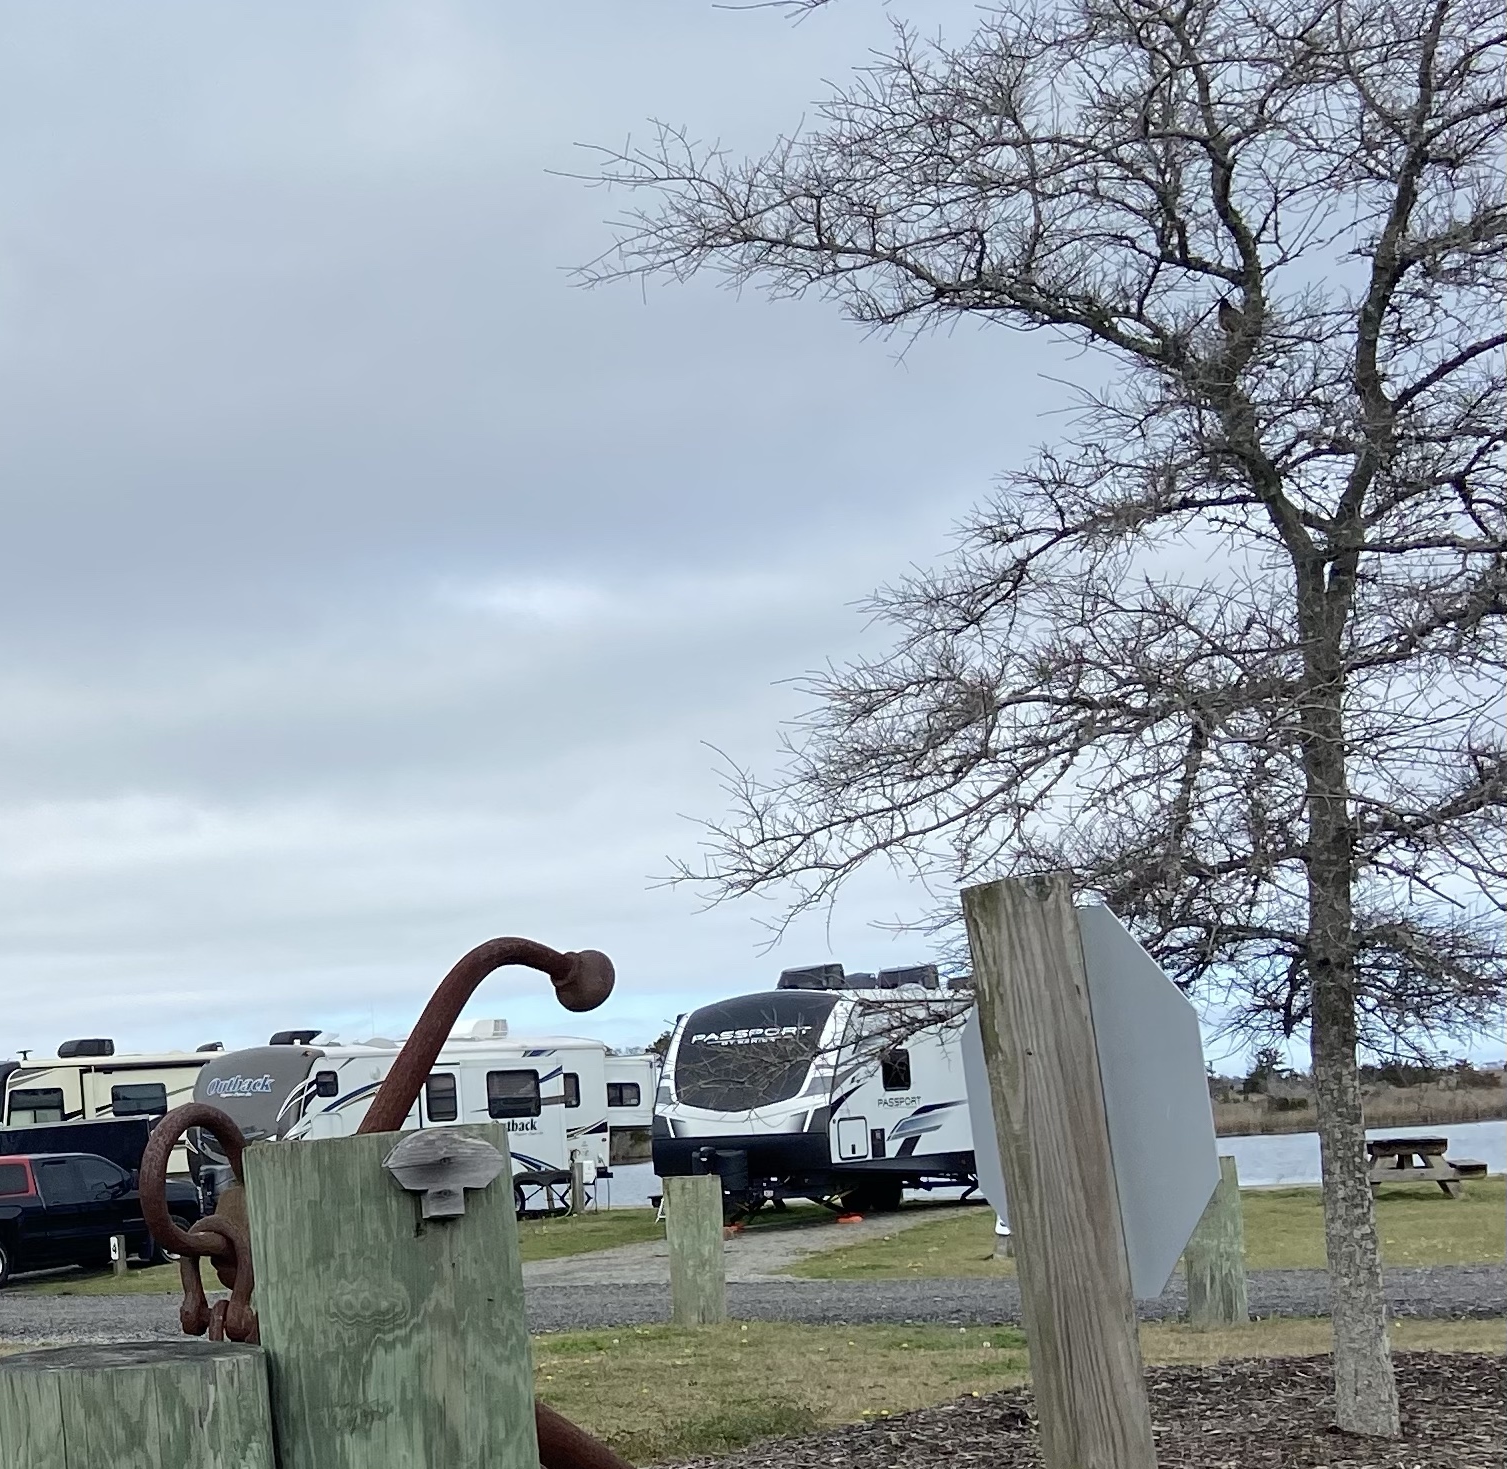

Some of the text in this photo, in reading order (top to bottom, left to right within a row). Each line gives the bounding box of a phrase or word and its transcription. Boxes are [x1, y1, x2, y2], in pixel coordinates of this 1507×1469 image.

[691, 1026, 812, 1044] PASSPORT
[207, 1074, 275, 1096] Outback
[878, 1096, 922, 1108] PASSPORT
[507, 1118, 538, 1132] tback
